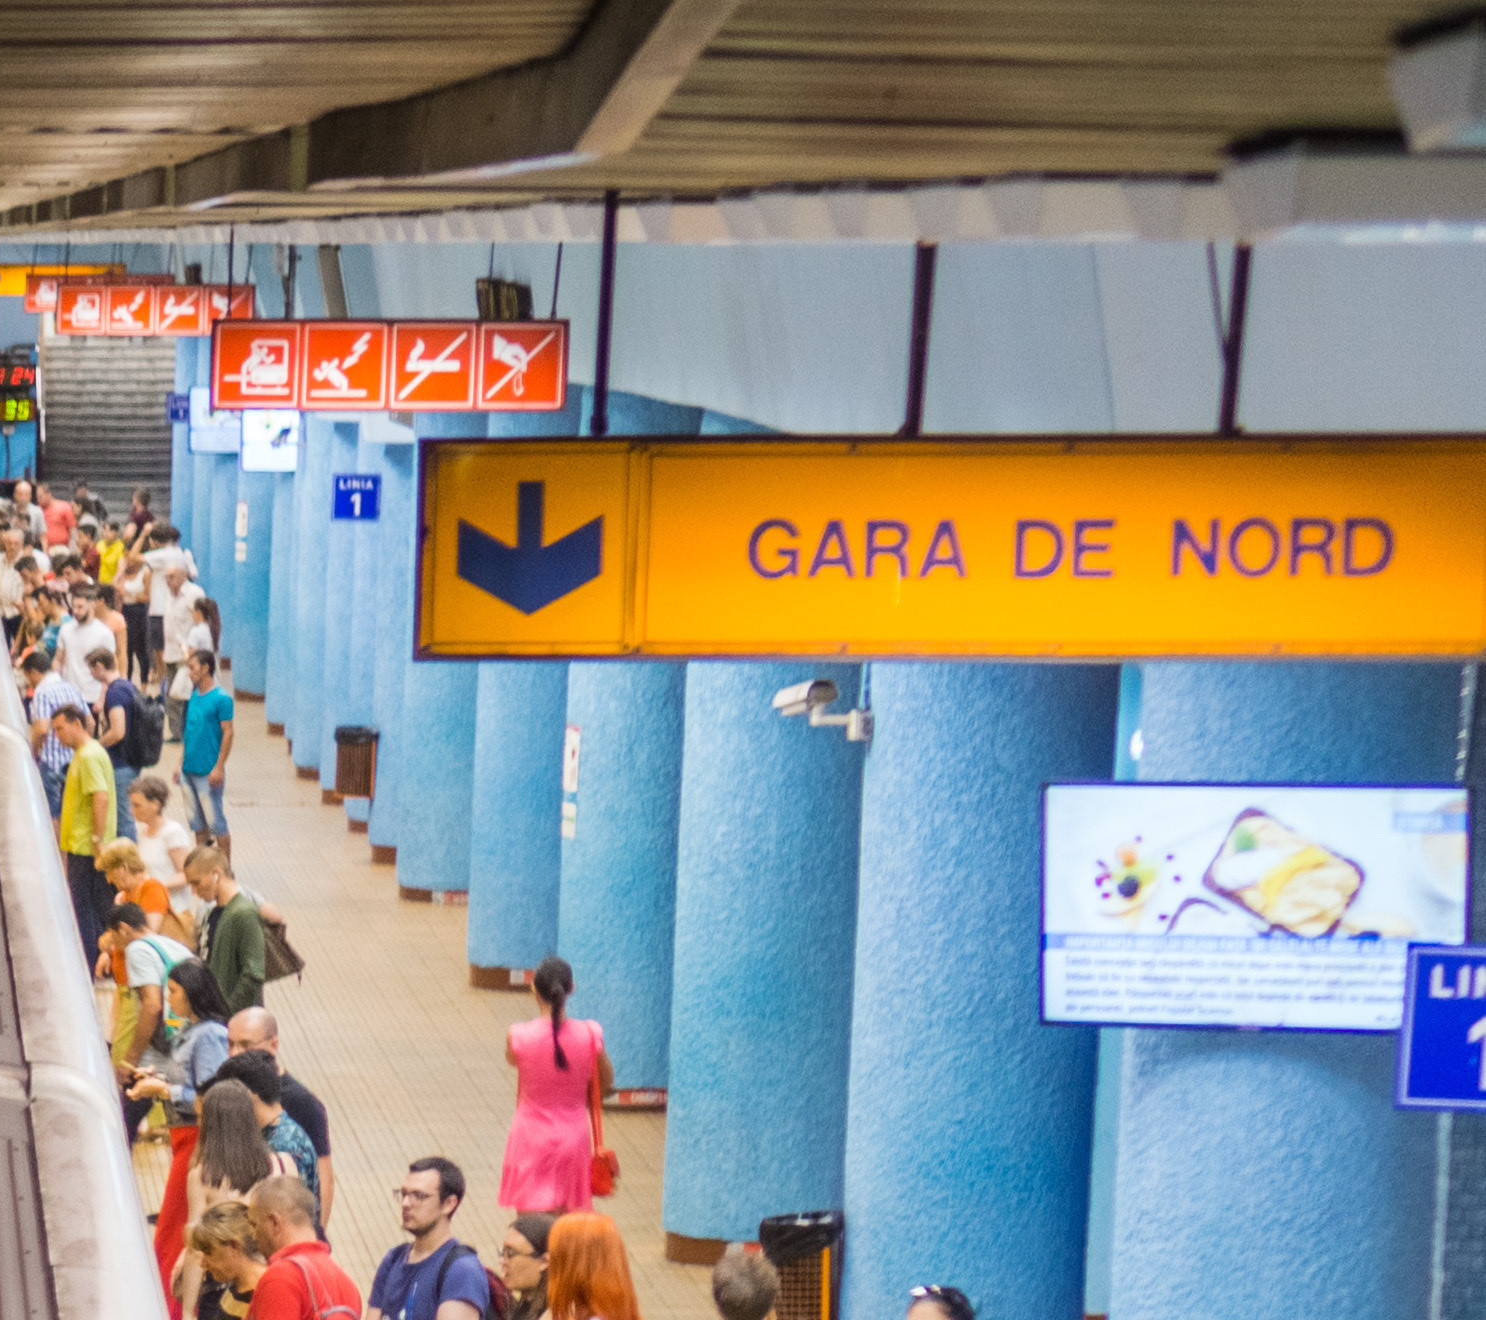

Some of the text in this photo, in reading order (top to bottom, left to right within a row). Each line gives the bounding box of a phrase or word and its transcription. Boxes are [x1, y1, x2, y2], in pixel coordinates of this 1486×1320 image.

[338, 478, 375, 490] LINIA
[350, 492, 362, 517] 1
[747, 517, 1396, 580] GARA DE NORD
